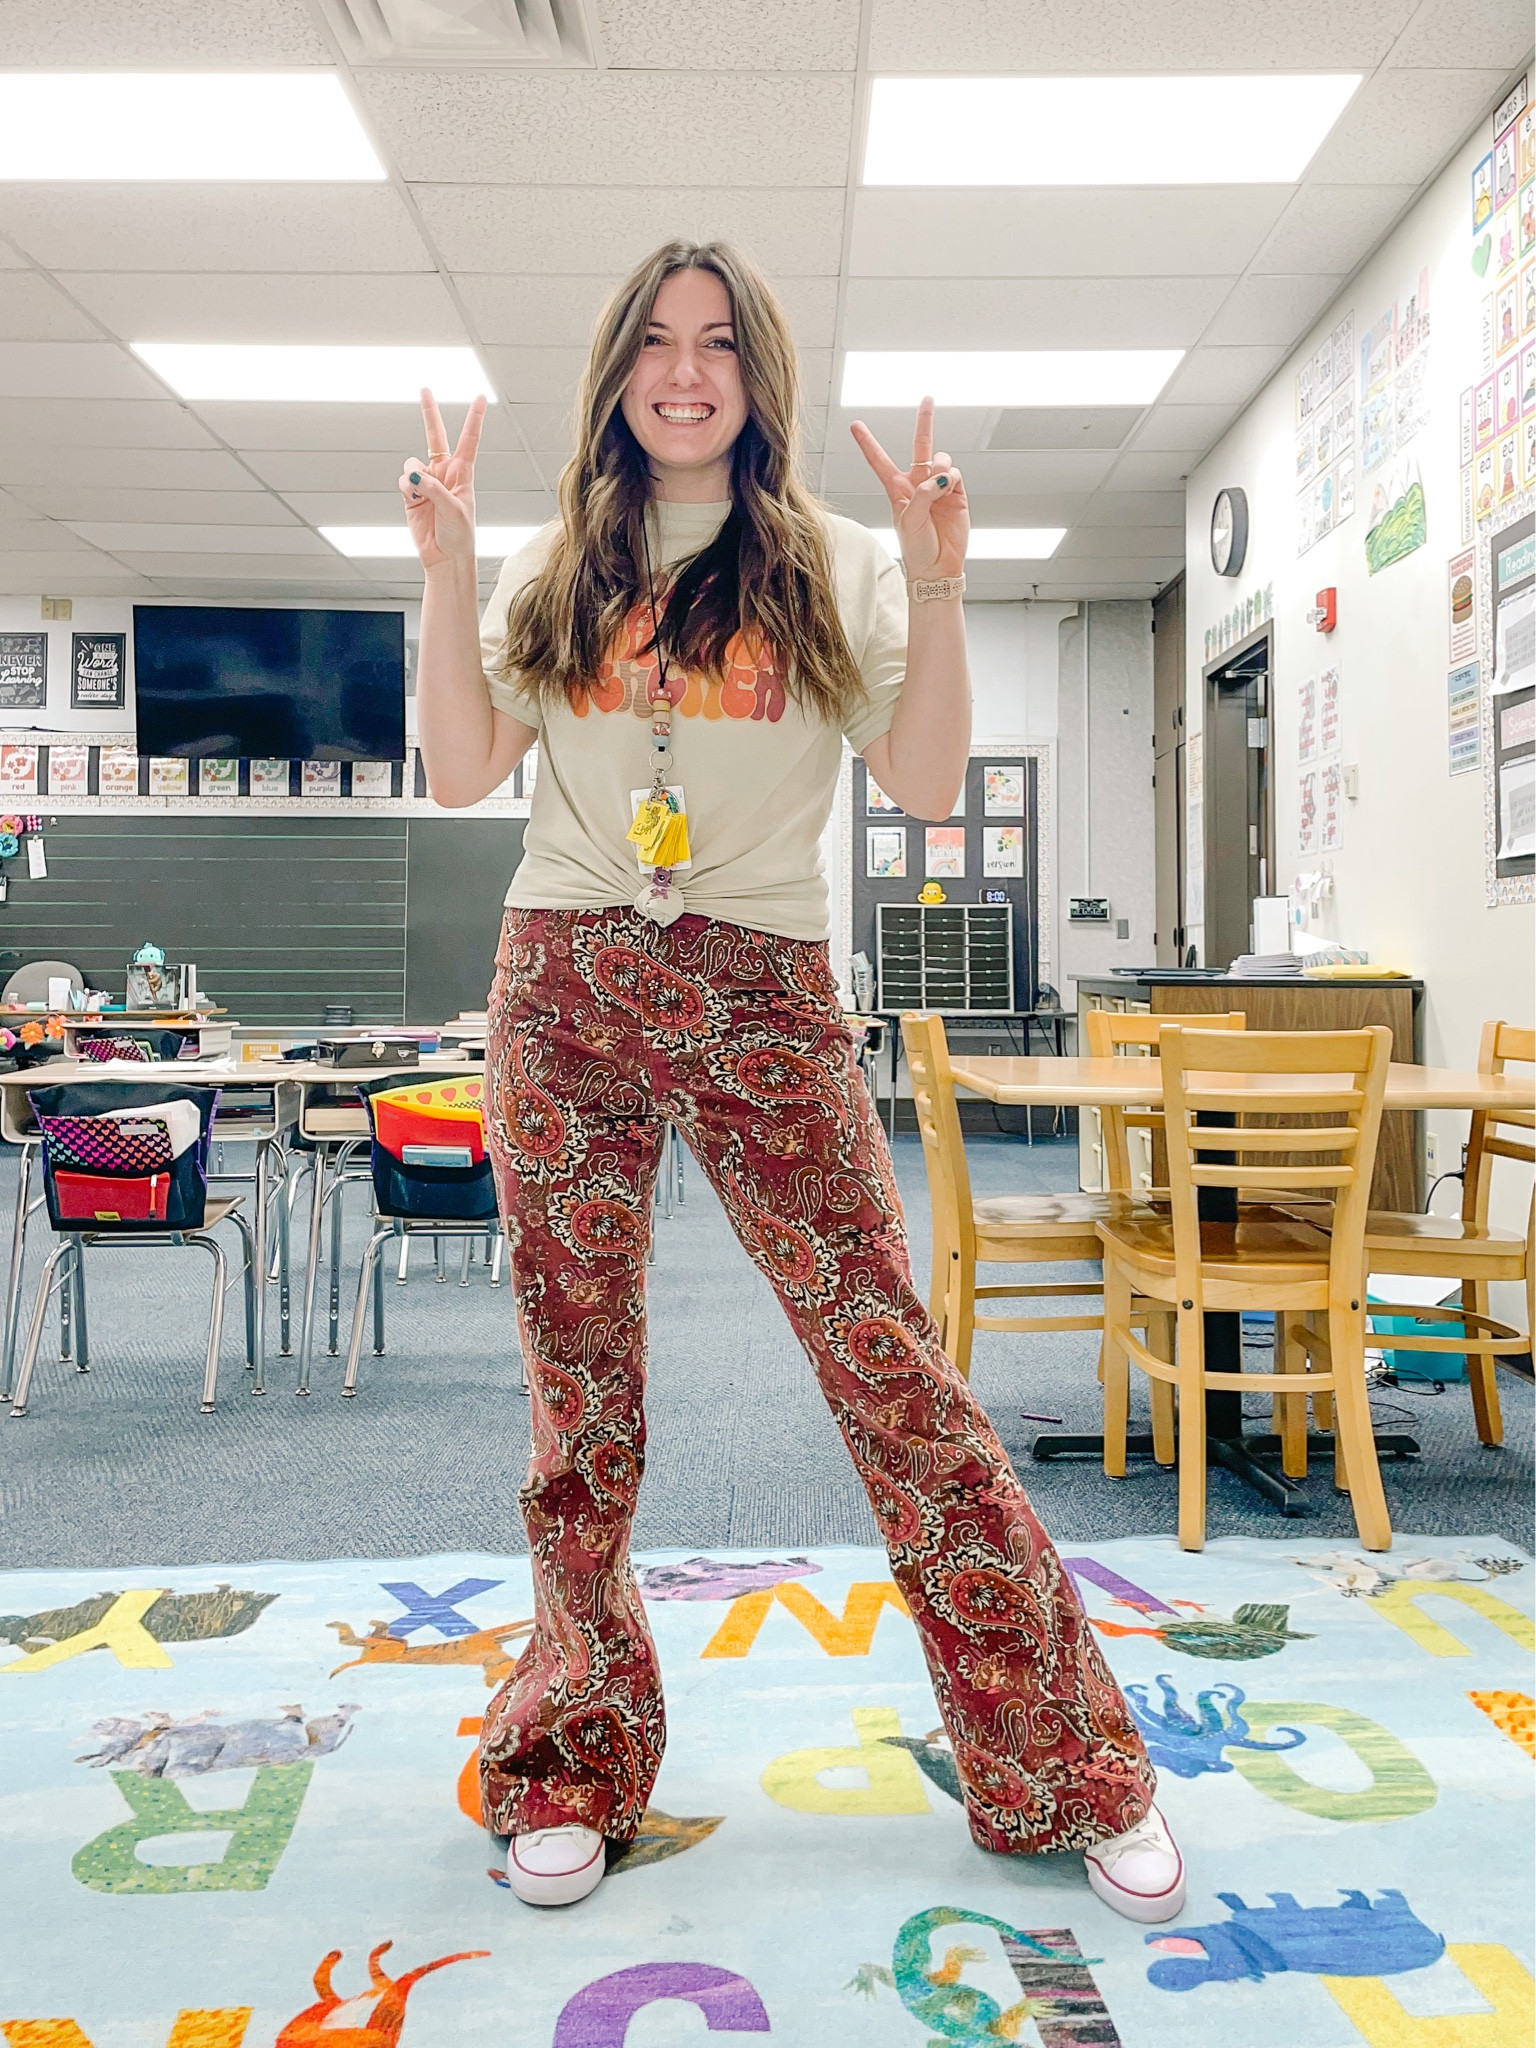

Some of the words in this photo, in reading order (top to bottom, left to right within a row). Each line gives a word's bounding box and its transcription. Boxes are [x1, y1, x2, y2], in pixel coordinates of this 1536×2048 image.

[94, 642, 117, 653] ONE
[0, 654, 43, 667] NEVER
[77, 652, 118, 668] Word
[10, 666, 35, 676] STOP
[0, 668, 43, 687] Learning
[77, 676, 117, 690] SOMEONE'S
[566, 656, 786, 723] EACHER
[12, 783, 25, 791] red
[60, 783, 77, 792] pink
[106, 784, 133, 792] orange
[157, 783, 182, 792] yellow
[208, 784, 231, 793] green
[262, 784, 279, 792] blue
[309, 784, 334, 793] purple
[986, 891, 1005, 902] 8:00
